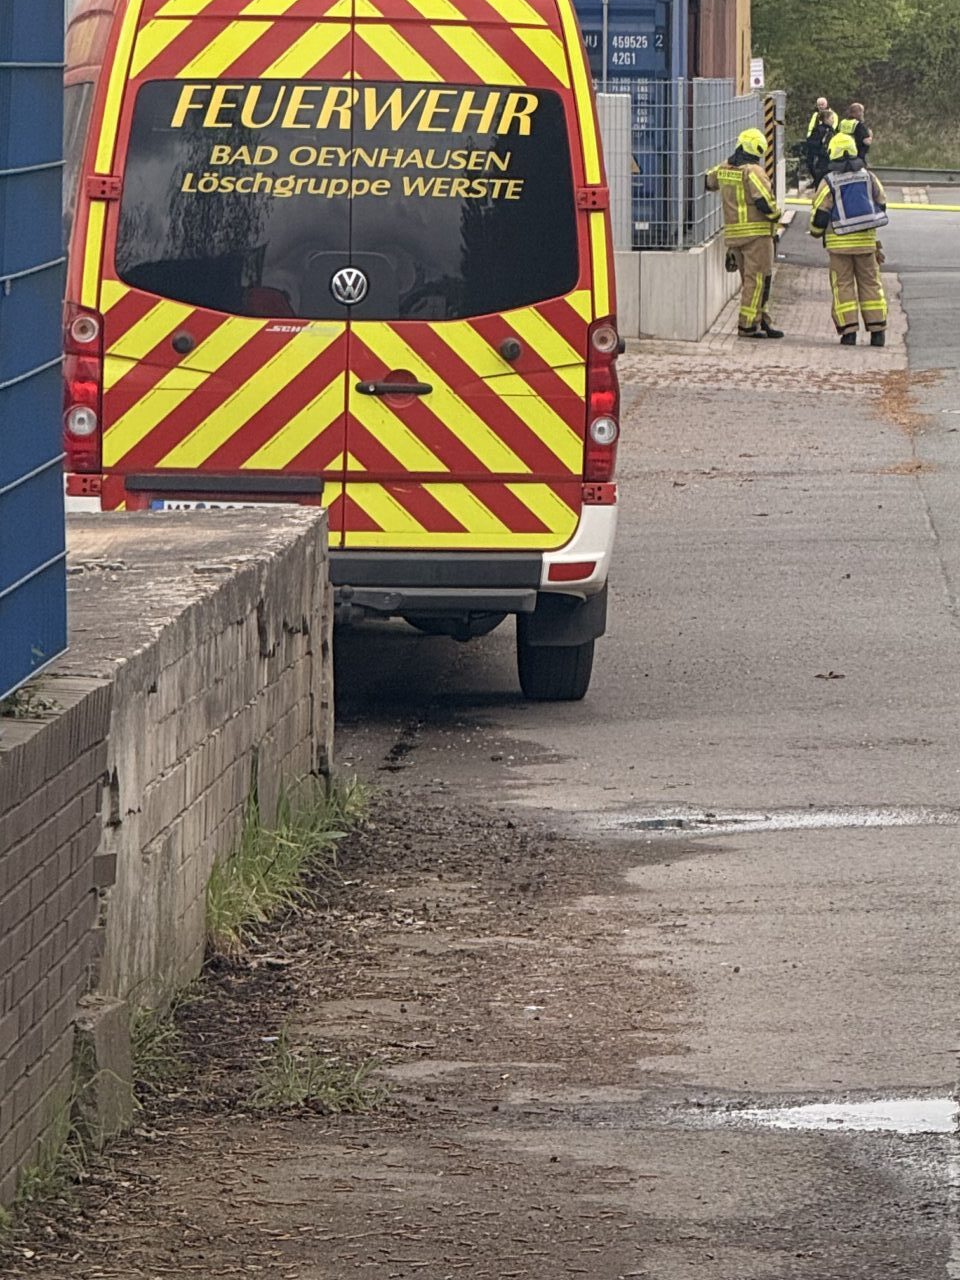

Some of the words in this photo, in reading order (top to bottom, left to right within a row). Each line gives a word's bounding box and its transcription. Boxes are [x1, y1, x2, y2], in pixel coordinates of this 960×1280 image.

[612, 36, 648, 48] 459525
[655, 35, 663, 47] 2
[612, 52, 636, 65] 42G1
[170, 84, 539, 136] FEUERWEHR
[210, 145, 278, 166] BAD
[289, 146, 511, 171] OEYNHAUSEN
[181, 173, 391, 199] Löschgruppe
[402, 176, 524, 200] WERSTE
